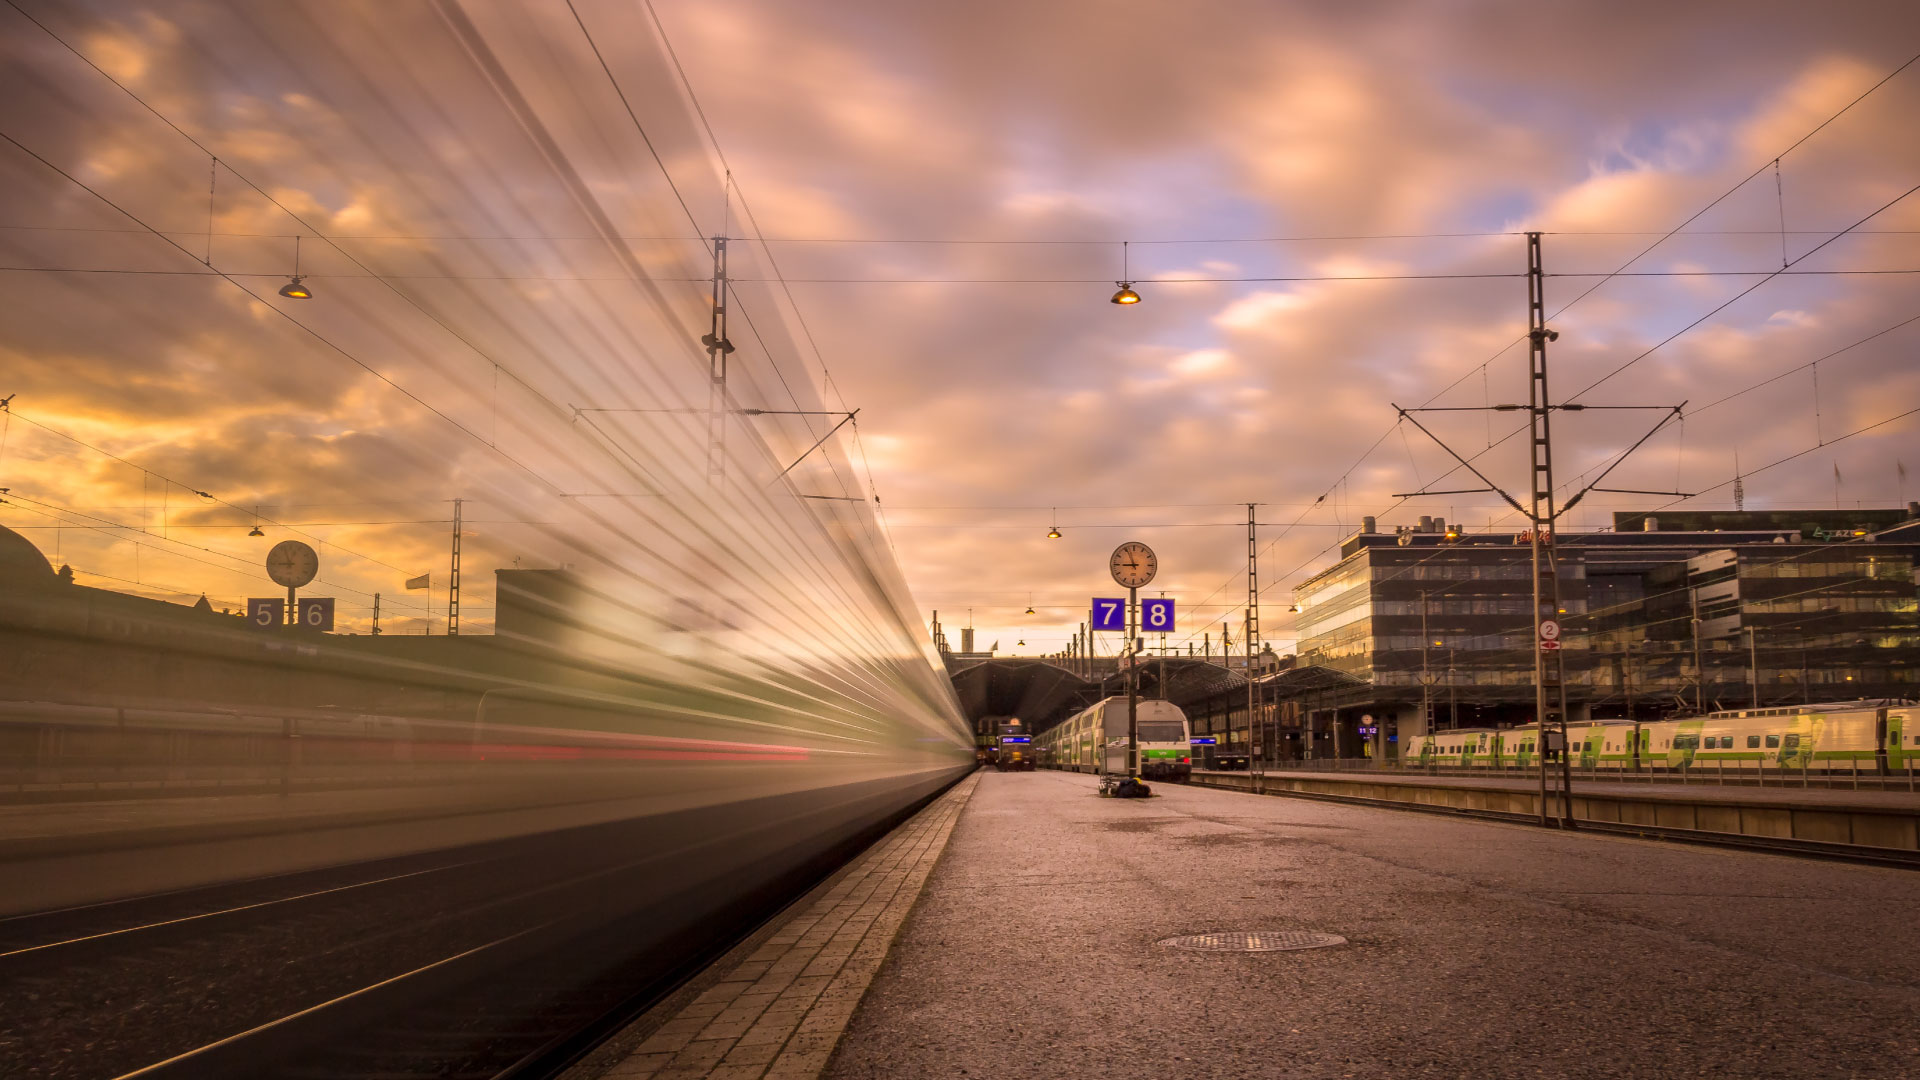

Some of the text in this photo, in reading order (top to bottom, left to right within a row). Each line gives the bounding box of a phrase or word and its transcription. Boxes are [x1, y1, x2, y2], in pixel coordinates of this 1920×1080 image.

[256, 603, 272, 626] 5
[307, 604, 323, 626] 6
[1100, 603, 1117, 625] 7
[1150, 604, 1167, 627] 8
[1546, 625, 1553, 636] 2
